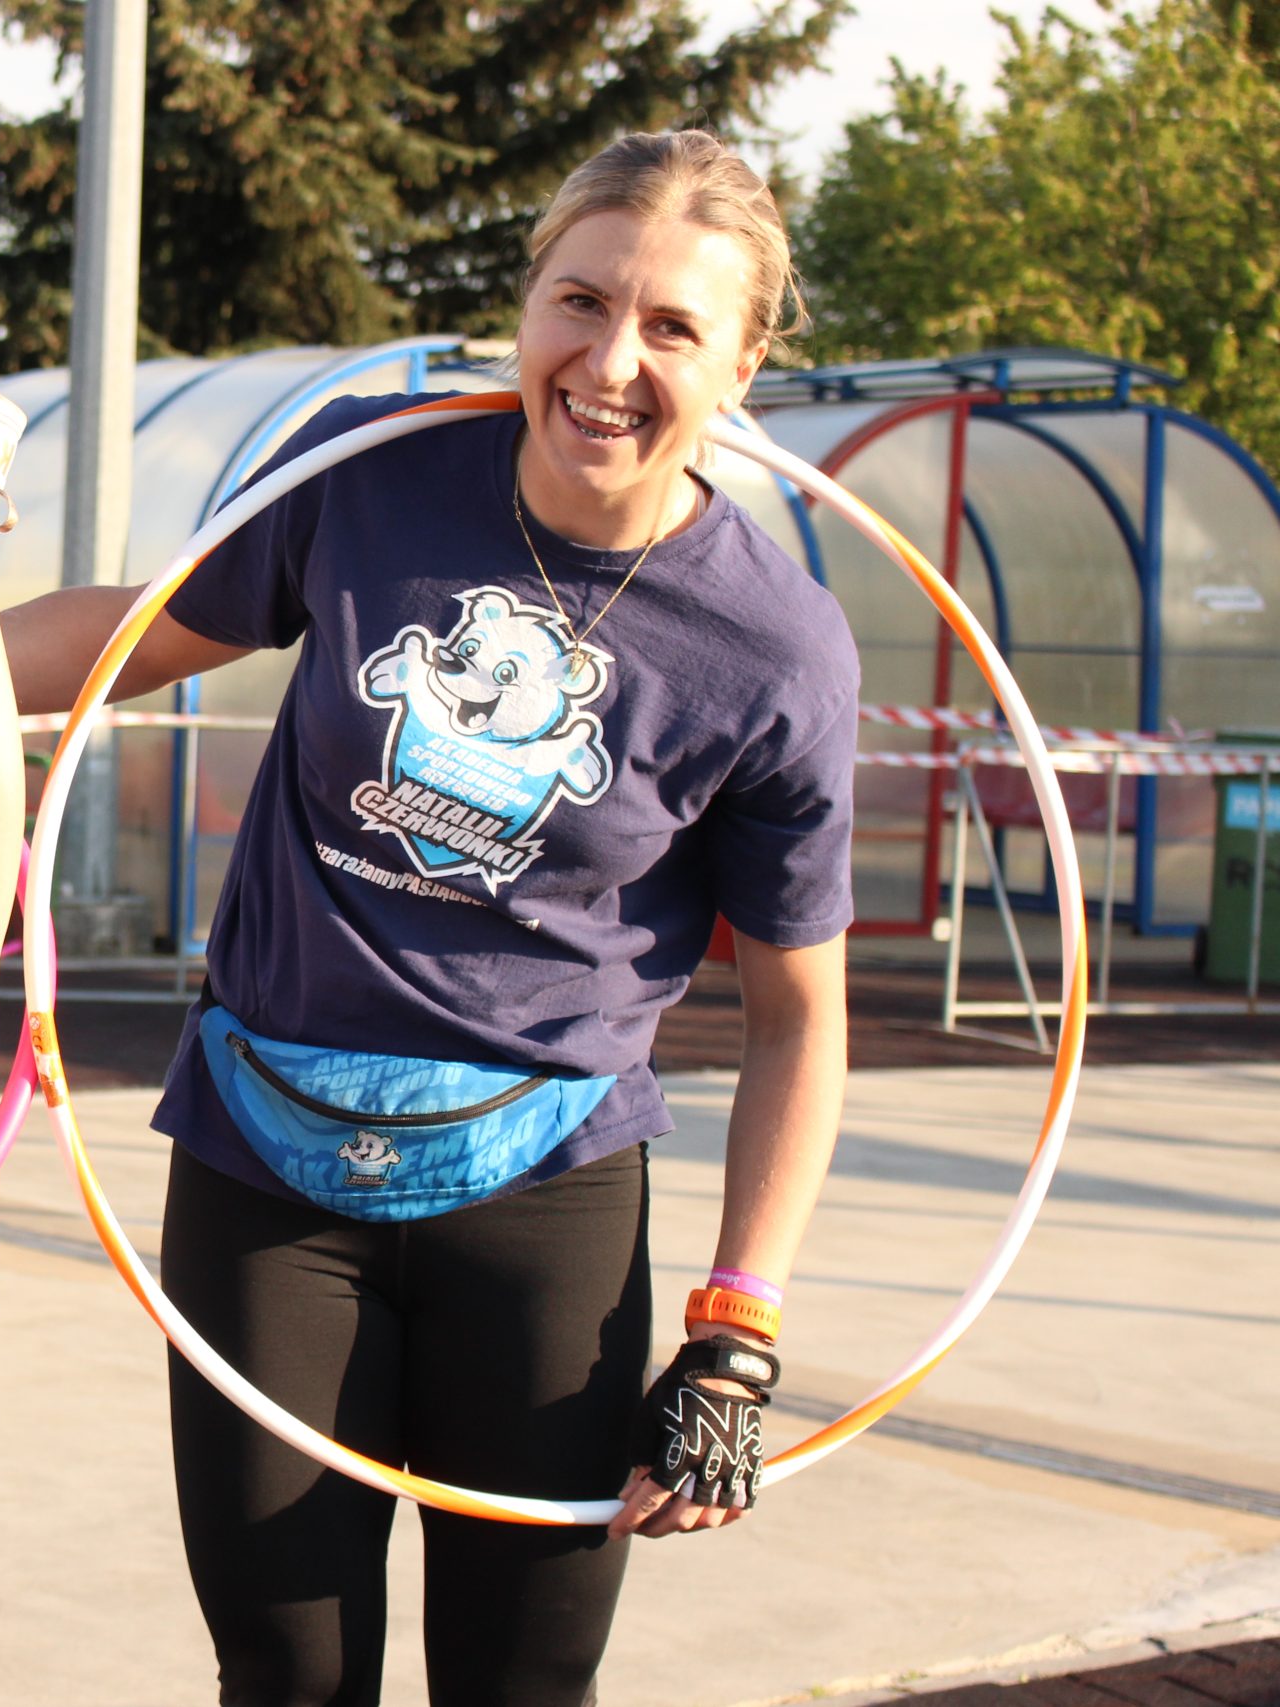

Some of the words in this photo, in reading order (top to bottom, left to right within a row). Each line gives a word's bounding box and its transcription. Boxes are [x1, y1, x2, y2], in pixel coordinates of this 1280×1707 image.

[407, 744, 534, 807] SPORTOWEGO
[359, 788, 525, 871] CZERWONKI
[391, 780, 504, 839] NATALII
